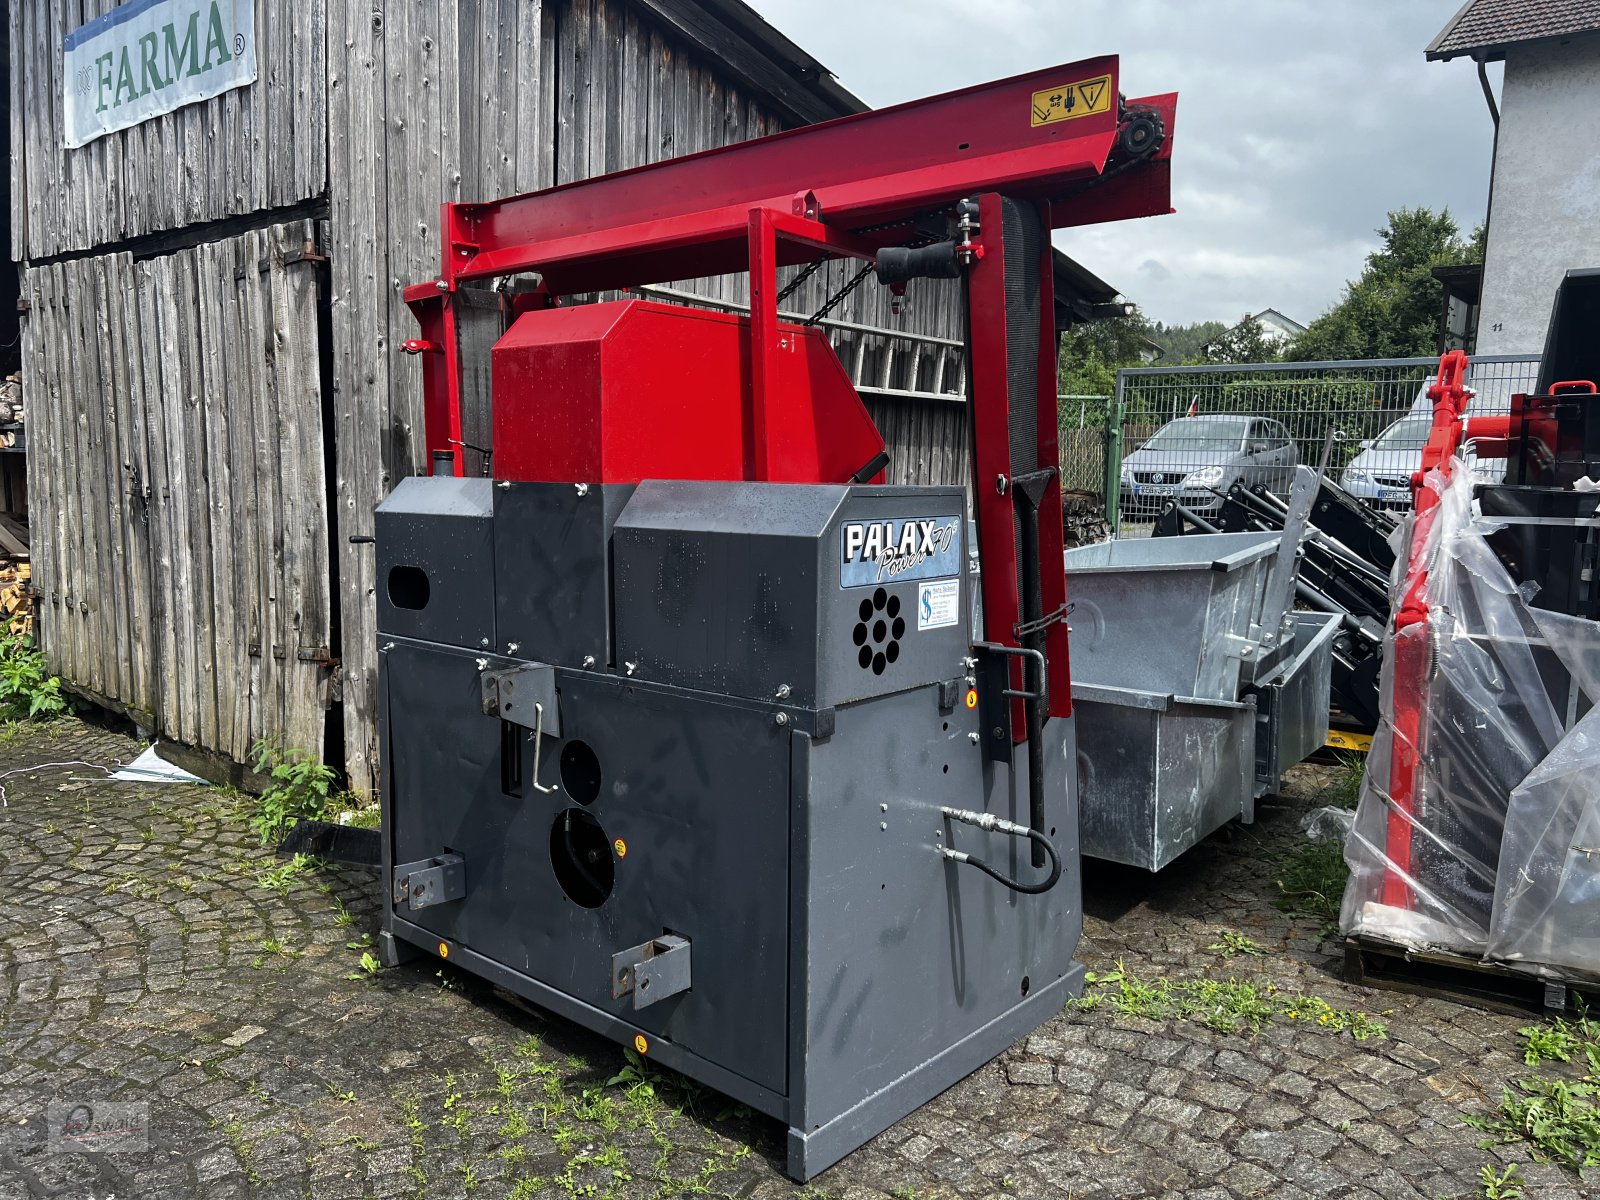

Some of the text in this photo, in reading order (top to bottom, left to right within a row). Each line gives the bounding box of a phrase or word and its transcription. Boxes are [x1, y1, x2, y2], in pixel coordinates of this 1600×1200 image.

[96, 0, 232, 114] FARMA
[1492, 322, 1503, 332] 11
[843, 519, 936, 564] PALAX
[874, 545, 926, 582] Power
